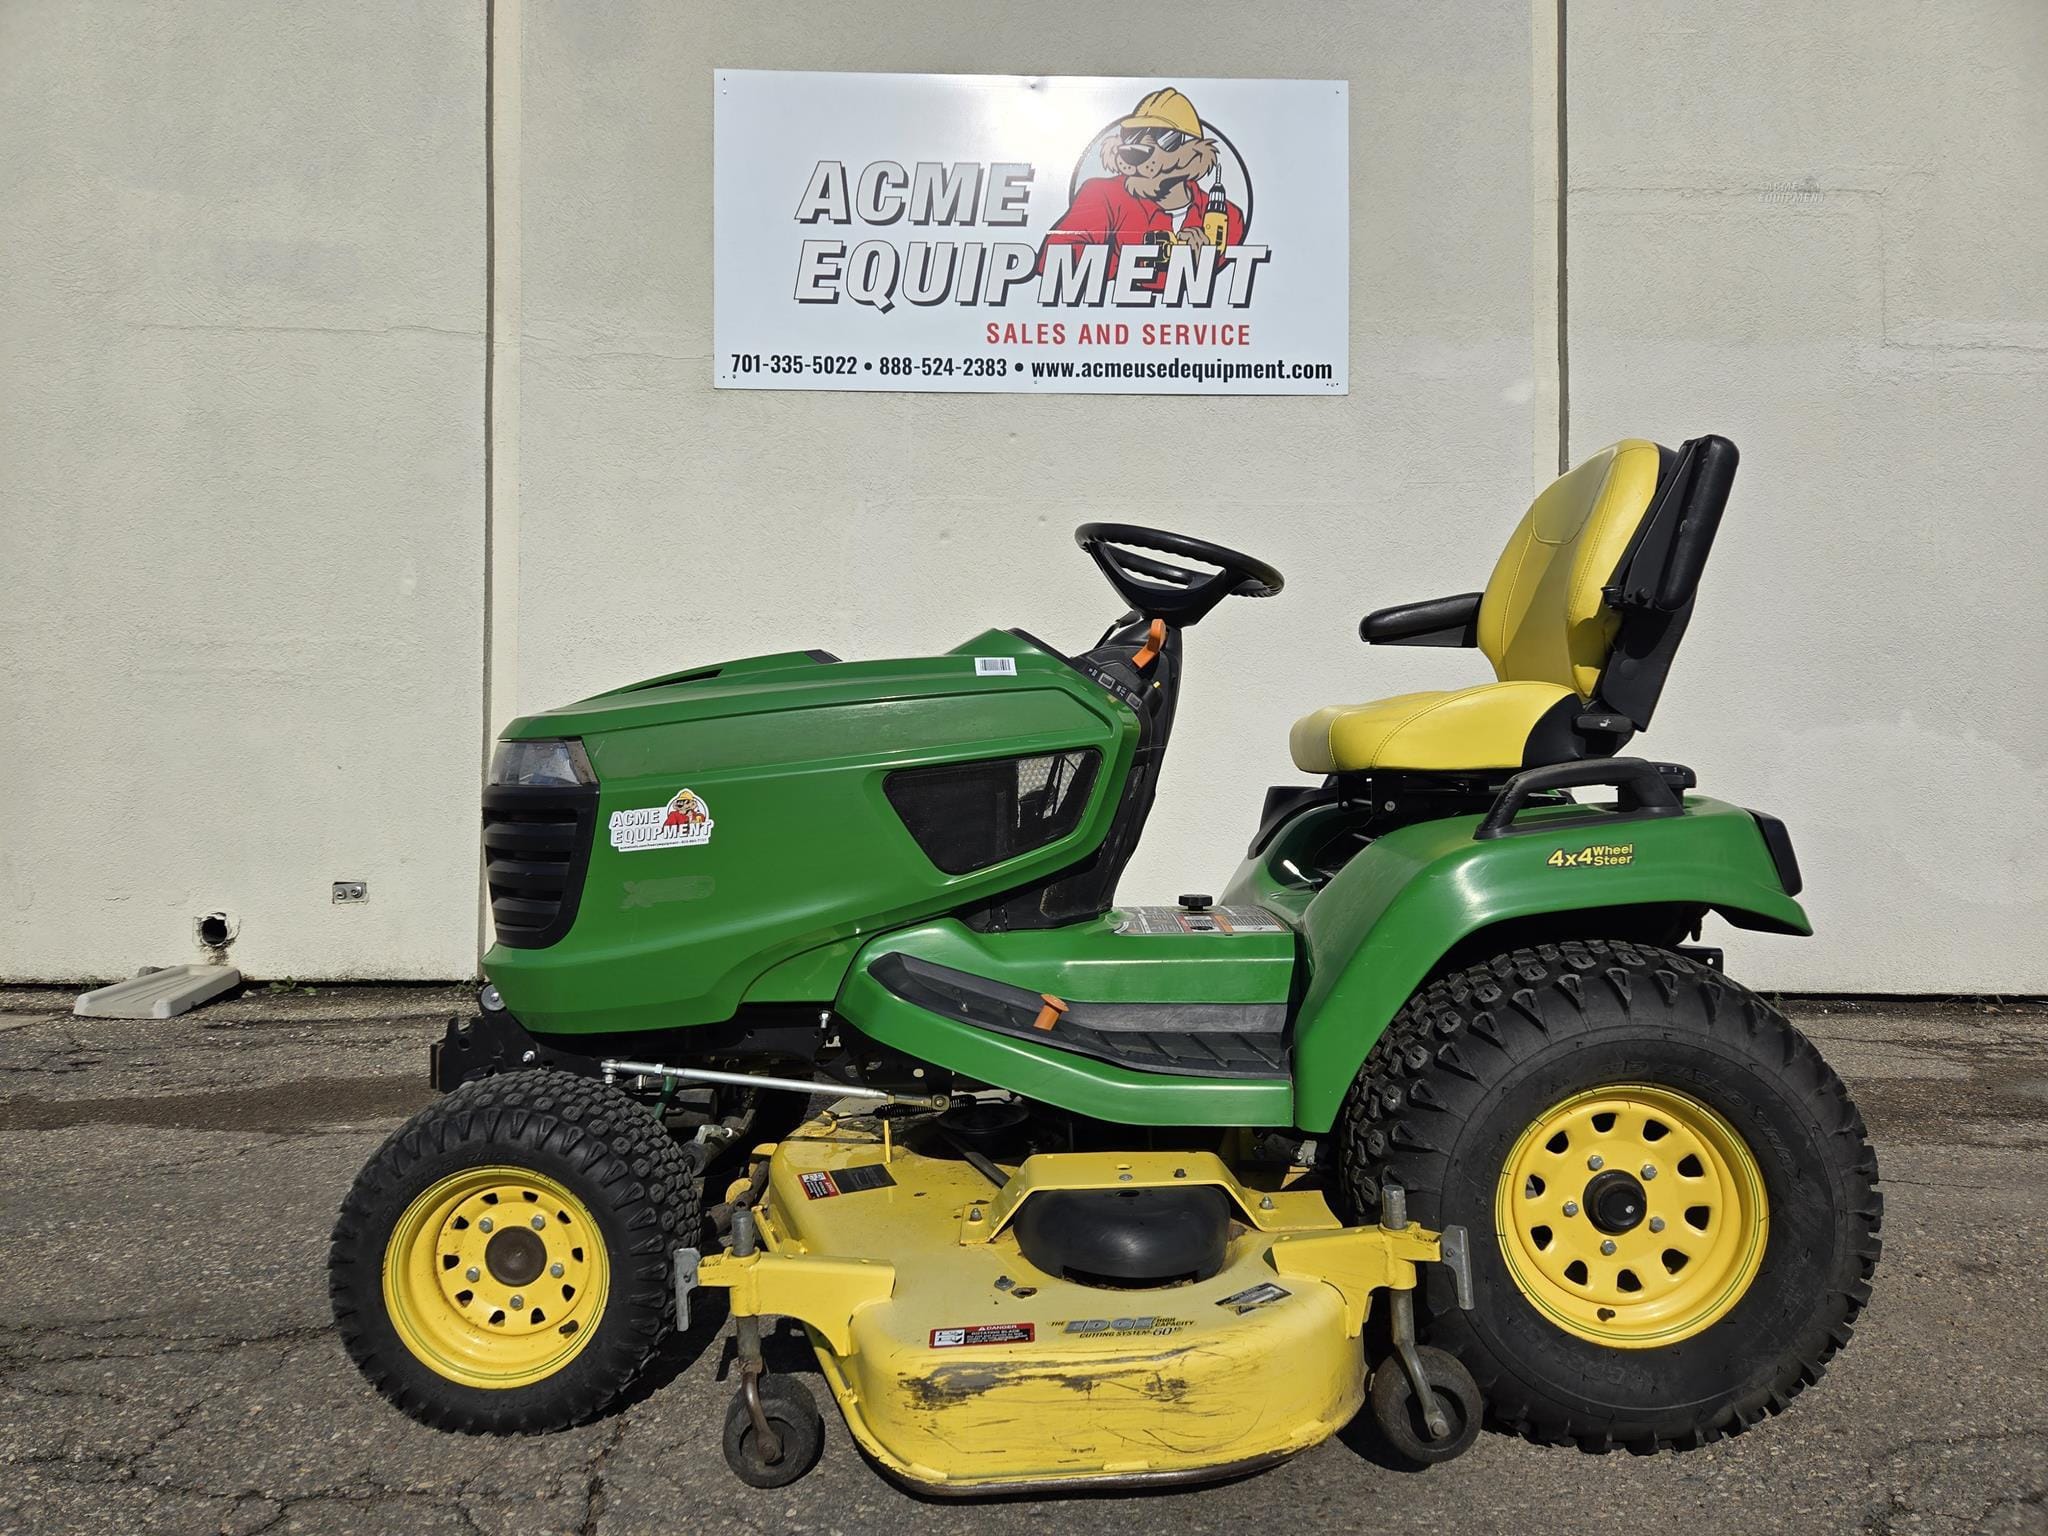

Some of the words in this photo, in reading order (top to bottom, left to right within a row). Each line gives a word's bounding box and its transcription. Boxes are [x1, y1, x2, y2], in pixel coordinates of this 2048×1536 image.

[794, 160, 1035, 227] ACME
[793, 239, 1272, 314] EQUIPMENT
[986, 322, 1066, 345] SALES
[1077, 323, 1130, 345] AND
[1141, 323, 1251, 346] SERVICE
[731, 354, 857, 375] 701-335-5022
[879, 356, 1007, 377] 888-524-2383
[1031, 358, 1333, 383] www.acmeusedequipment.com
[611, 810, 661, 828] ACME
[612, 822, 712, 845] EQUIPMENT
[1547, 847, 1593, 867] 4x4
[1592, 844, 1633, 857] Wheel
[1593, 855, 1633, 866] Steer
[1079, 1331, 1114, 1339] CUTTING
